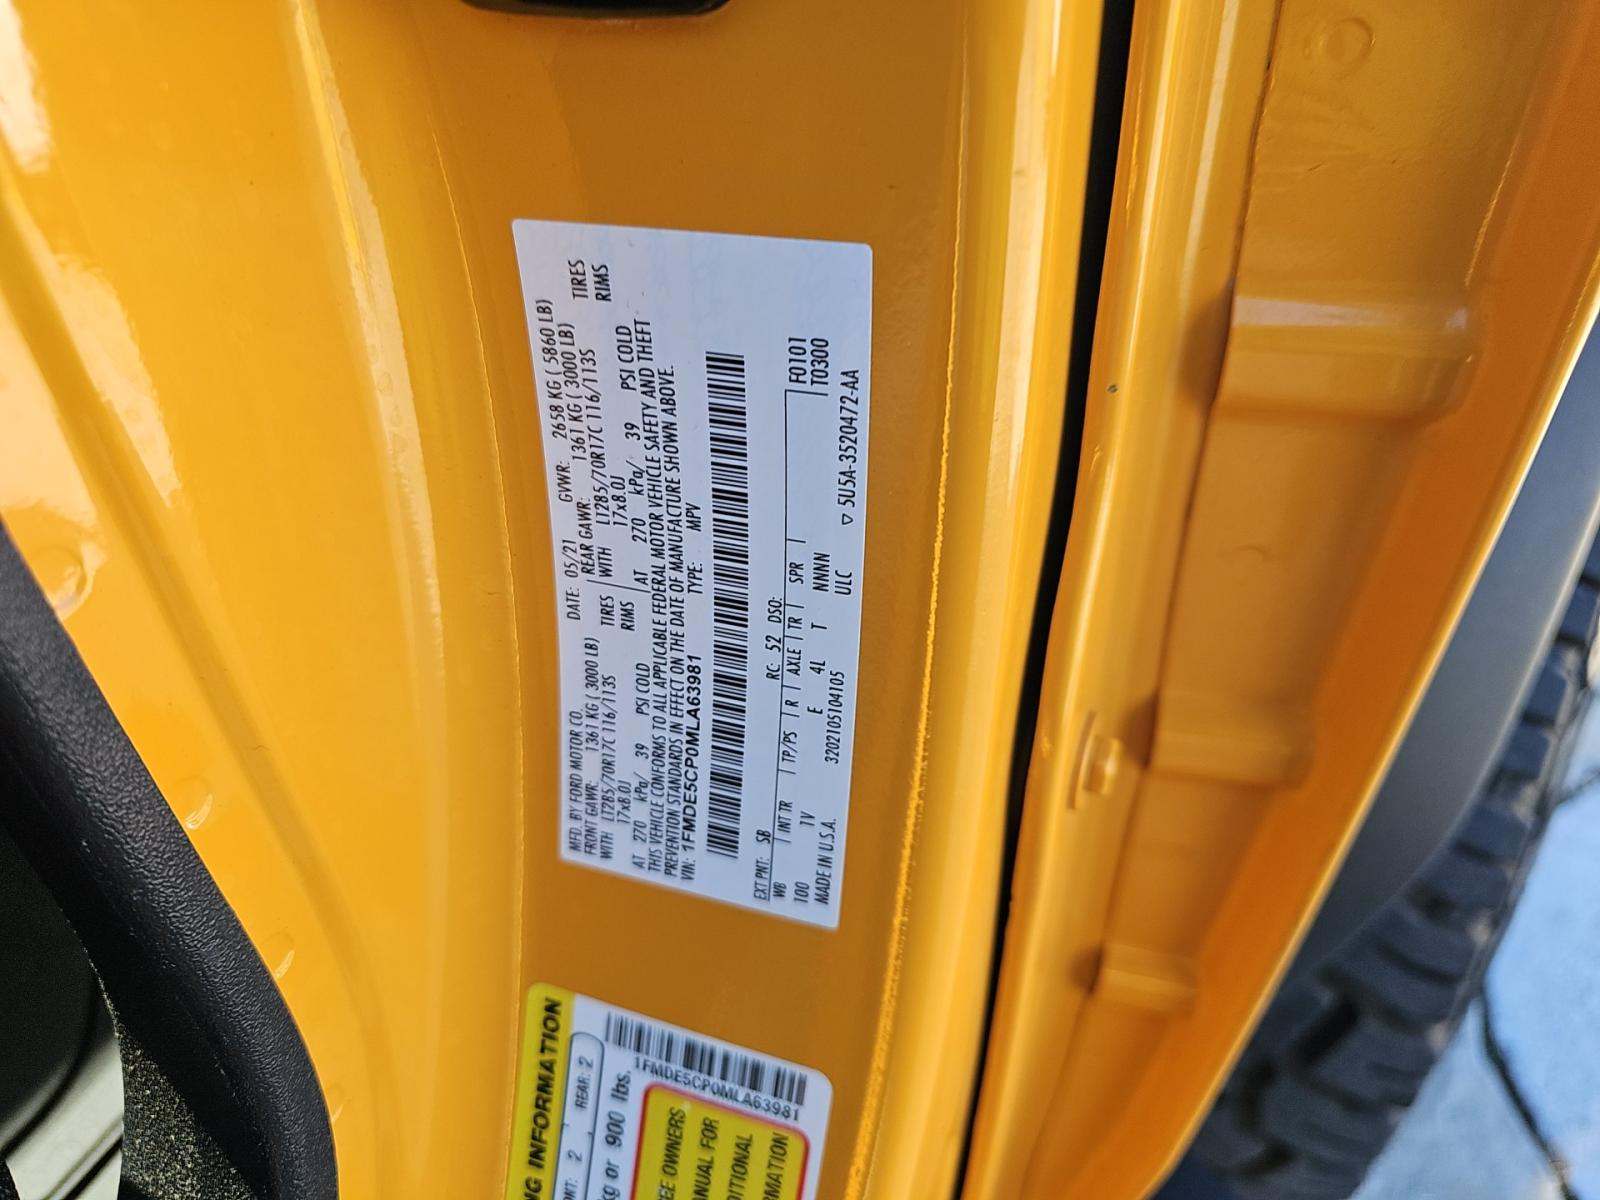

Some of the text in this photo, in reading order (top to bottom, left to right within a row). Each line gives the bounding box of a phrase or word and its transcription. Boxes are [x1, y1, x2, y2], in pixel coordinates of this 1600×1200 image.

[568, 259, 588, 300] TIRES
[592, 264, 612, 302] RIMS
[536, 299, 554, 322] LB)
[540, 328, 558, 363] 5860
[557, 323, 575, 346] LB)
[615, 325, 633, 363] COLD
[561, 351, 579, 388] 3000
[579, 348, 601, 420] 116/113S
[619, 368, 636, 390] PSI
[547, 381, 562, 400] KG
[550, 405, 567, 440] 2658
[567, 404, 583, 422] KG
[571, 428, 587, 461] 1361
[624, 422, 641, 440] 39
[556, 461, 572, 502] GVWR:
[610, 474, 628, 527] 17x8.0J
[576, 497, 593, 539] GAWR:
[632, 518, 647, 543] 270
[580, 544, 595, 575] REAR
[598, 547, 612, 578] WITH
[686, 502, 703, 594] TYPE: MPV
[562, 539, 580, 620] DATE: 05/21
[634, 569, 648, 585] AT
[789, 562, 804, 585] SPR
[812, 552, 830, 592] NNNN
[835, 569, 852, 595] ULC
[600, 594, 615, 626] TIRES
[634, 319, 667, 872] THIS VEHICLE CONFORMS TO ALL APPLICABLE FEDERAL MOTOR VEHICLE SAFETY AND THEFT
[620, 601, 635, 631] RIMS
[657, 365, 685, 877] PREVENTION STANDARDS IN EFFECT ON THE DATE OF MANUFACTURE SHOWN ABOVE.
[788, 617, 802, 630] TR
[584, 637, 599, 656] LB)
[766, 635, 781, 652] 52
[586, 661, 599, 691] 3000
[766, 663, 780, 680] RC:
[787, 647, 801, 676] AXLE
[809, 660, 825, 675] 4L
[636, 663, 650, 694] COLD
[586, 703, 598, 720] KG
[602, 674, 618, 733] 116/113S
[636, 697, 650, 715] PSI
[785, 699, 799, 708] R
[807, 706, 823, 714] E
[586, 723, 598, 752] 1361
[635, 743, 649, 759] 39
[782, 730, 797, 763] TP/PS
[569, 708, 583, 852] MFD. BY FORD MOTOR CO.
[585, 781, 598, 817] GAWR:
[617, 778, 631, 825] 17x8.0J
[777, 799, 793, 833] INT TR
[584, 820, 597, 855] FRONT
[600, 831, 614, 859] WITH
[633, 820, 647, 843] 270
[632, 853, 646, 869] AT
[681, 858, 695, 881] VIN:
[754, 829, 771, 900] EXT PNT: SB
[818, 855, 833, 869] IN
[773, 881, 787, 898] WB
[794, 881, 809, 903] 100
[814, 870, 831, 904] MADE
[578, 1055, 594, 1068] 2
[528, 997, 561, 1170] INFORMATION
[609, 1070, 632, 1102] lbs.
[605, 1111, 626, 1148] 900
[699, 1116, 720, 1150] FOR
[568, 1149, 583, 1162] 2
[603, 1159, 620, 1179] or
